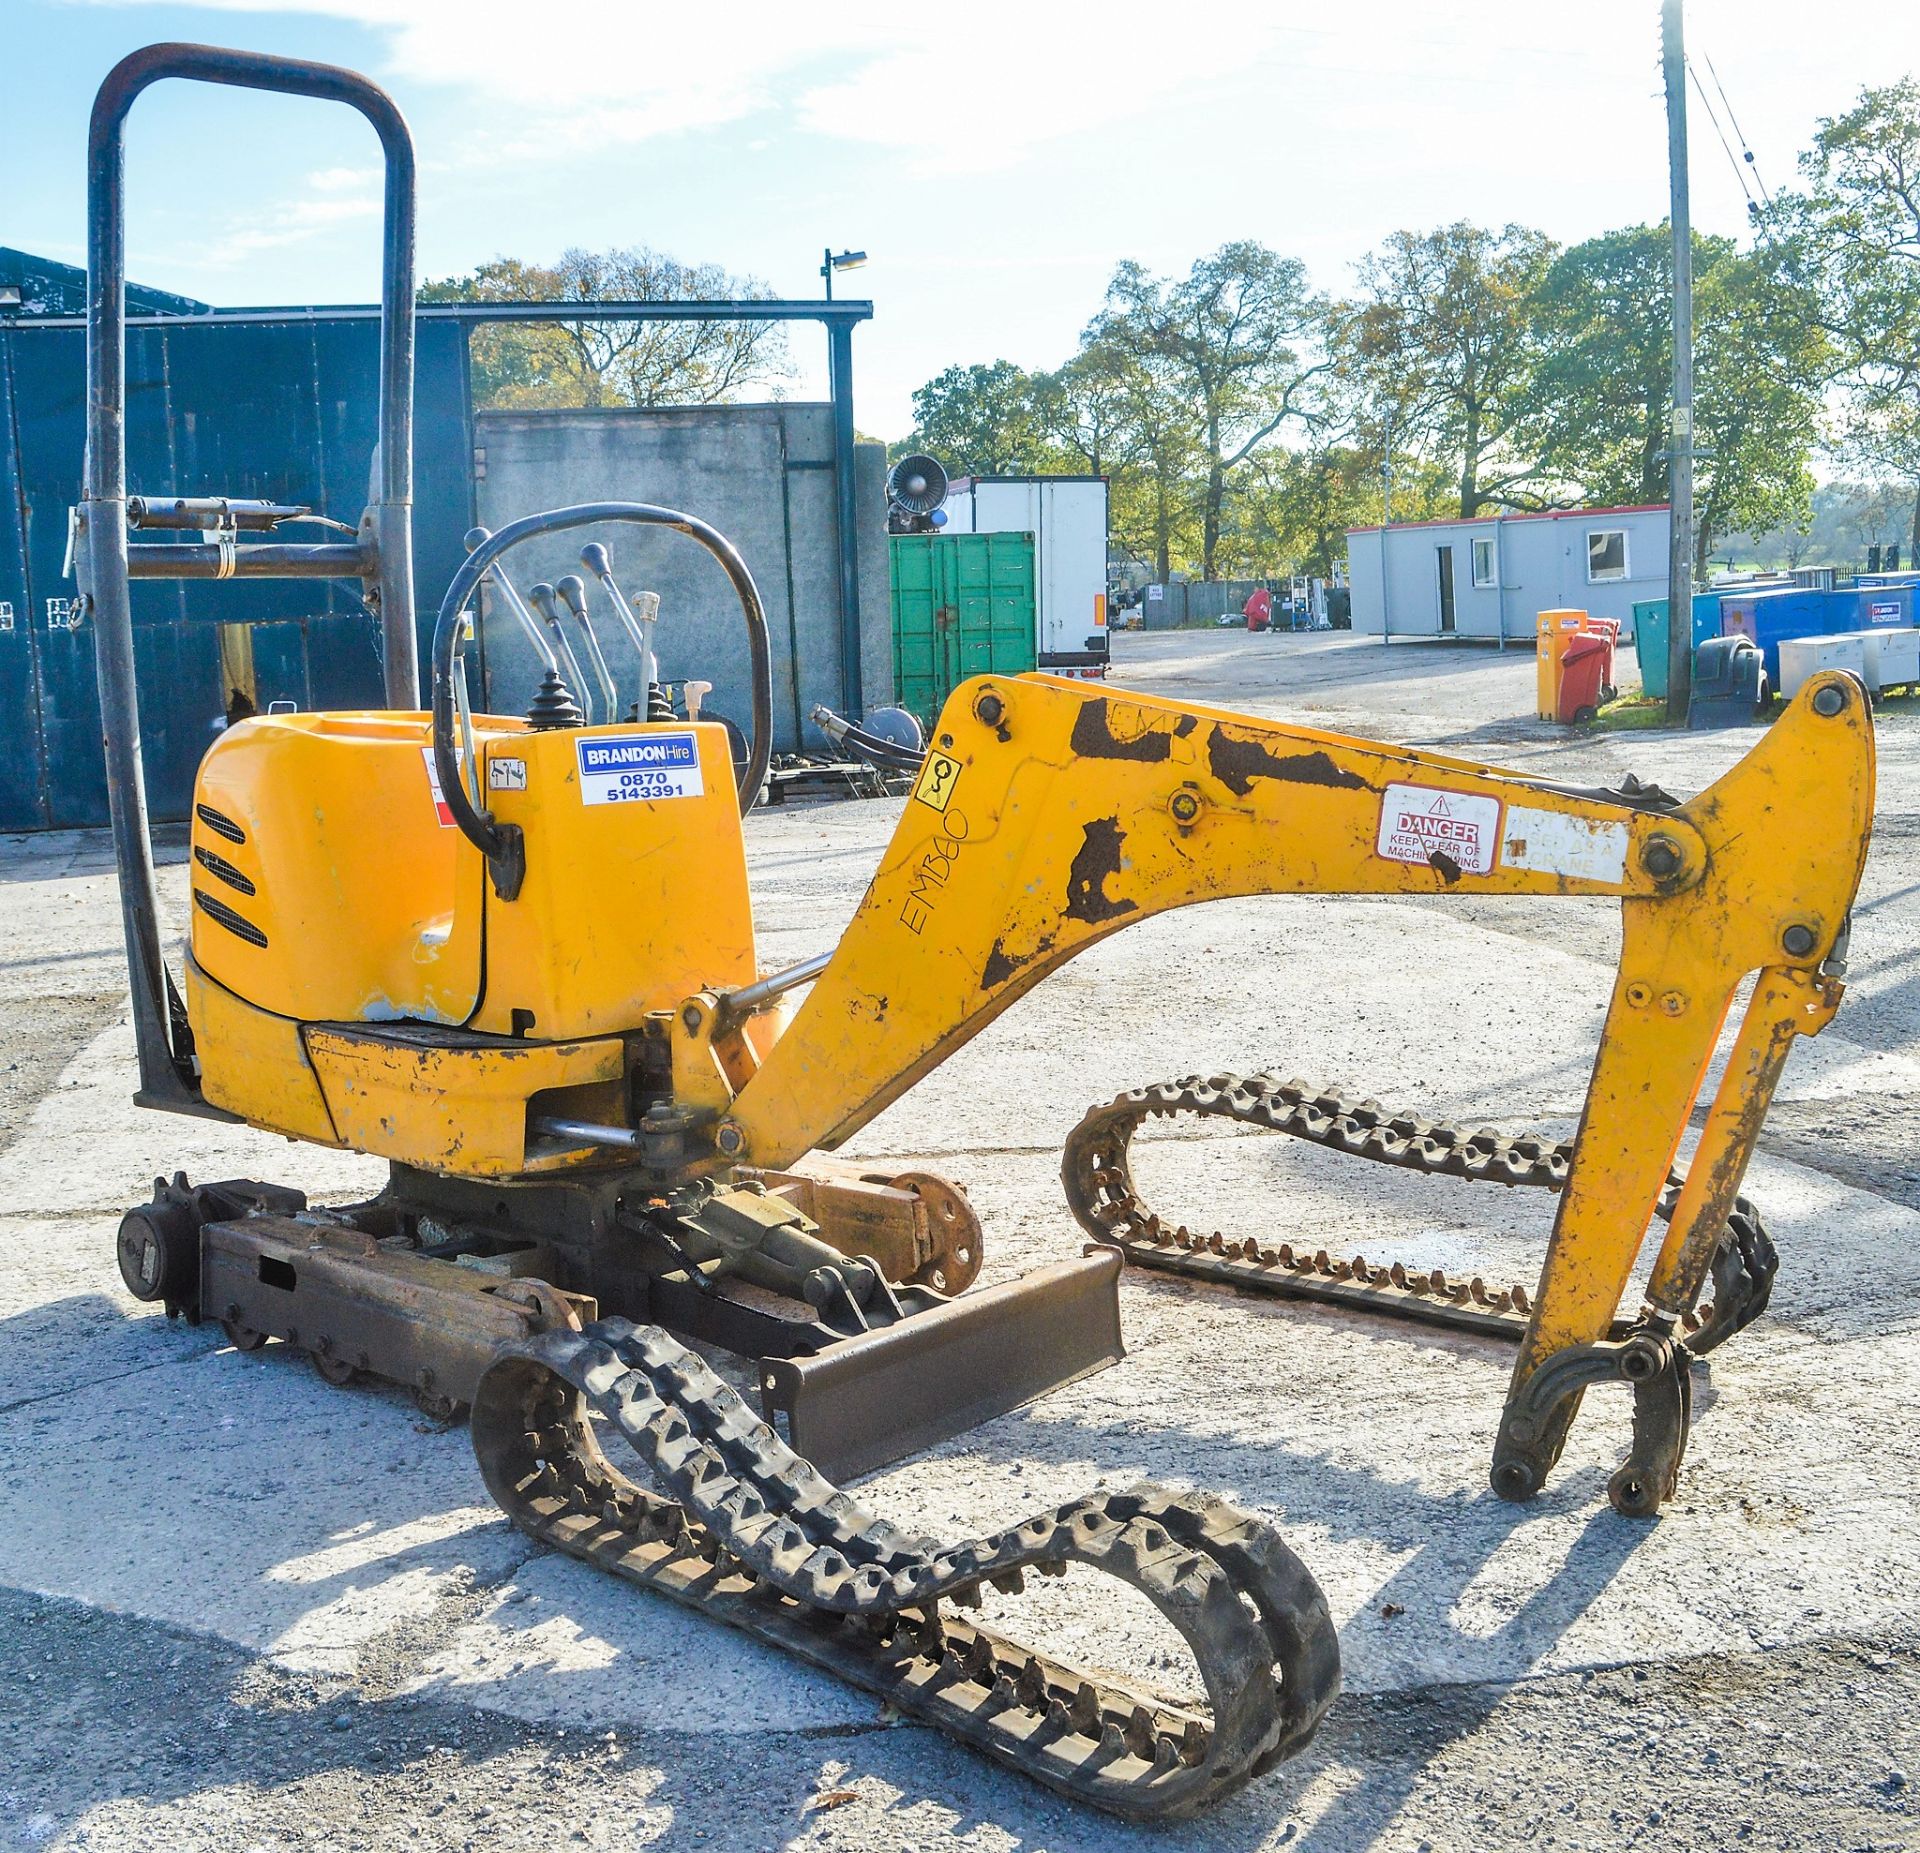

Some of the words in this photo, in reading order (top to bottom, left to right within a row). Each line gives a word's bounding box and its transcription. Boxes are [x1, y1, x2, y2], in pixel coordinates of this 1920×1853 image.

[619, 772, 668, 787] 0870
[607, 784, 684, 801] 5143391
[1397, 814, 1478, 843] DANGER
[1390, 834, 1420, 847] KEEP
[1424, 839, 1460, 854] CLEAR
[1465, 845, 1480, 857] OF
